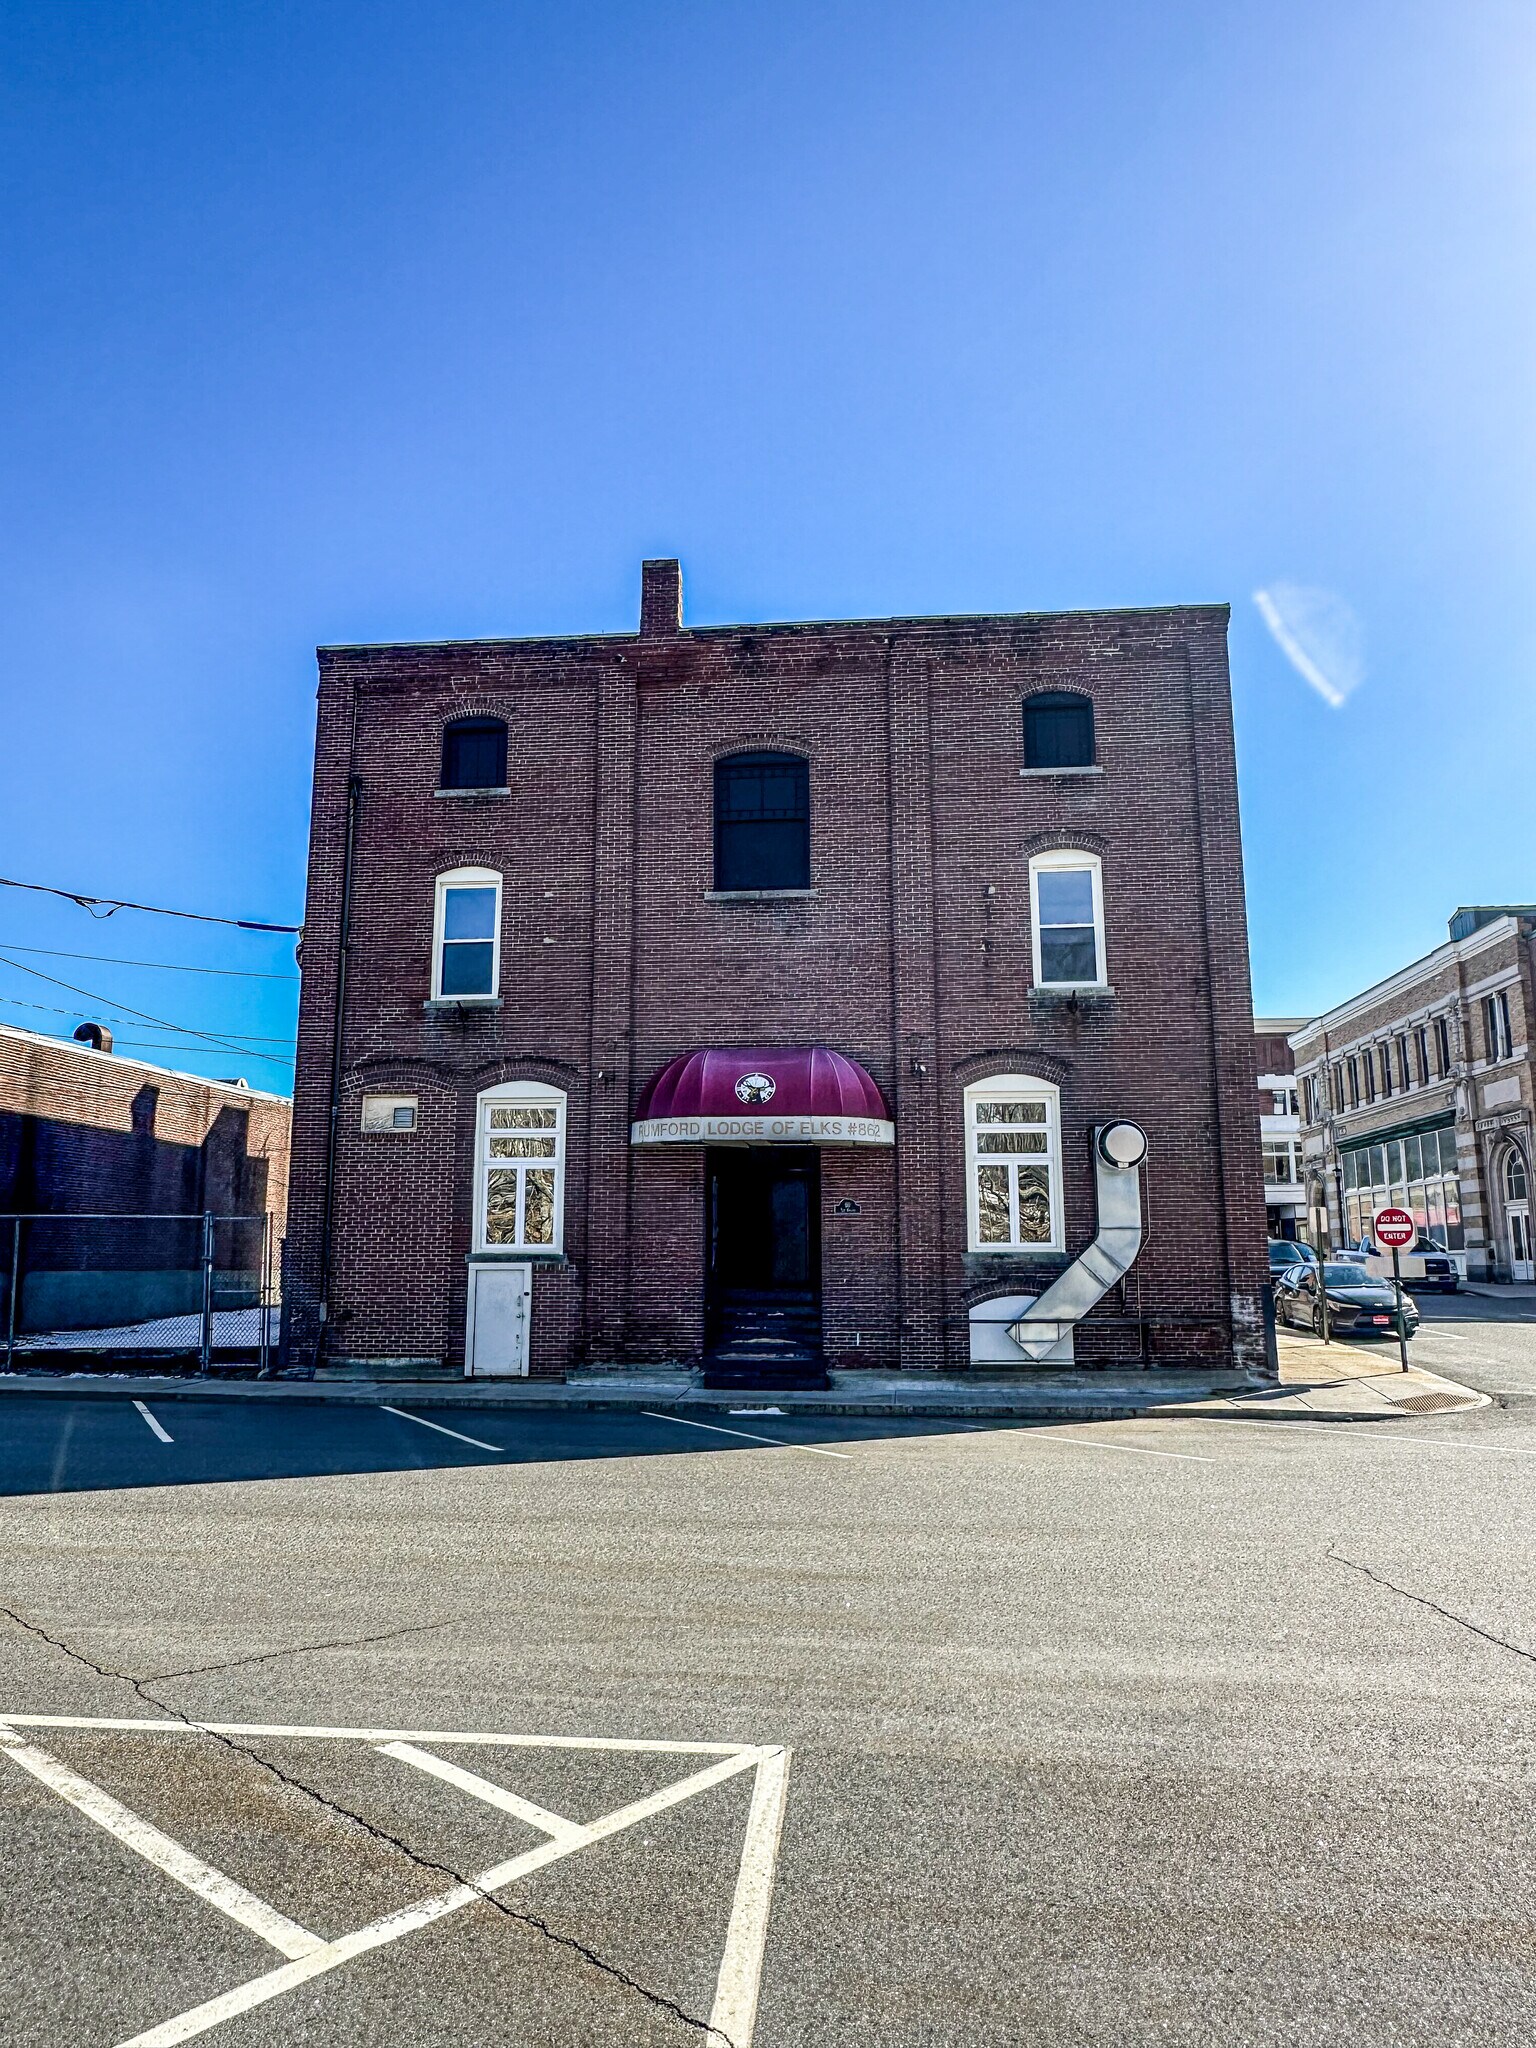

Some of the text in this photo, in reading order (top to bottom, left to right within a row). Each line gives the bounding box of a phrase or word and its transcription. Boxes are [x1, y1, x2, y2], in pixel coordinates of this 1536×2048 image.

[638, 1121, 881, 1137] RUMFORD LODGE OF ELKS #862
[1383, 1232, 1406, 1240] ENTER
